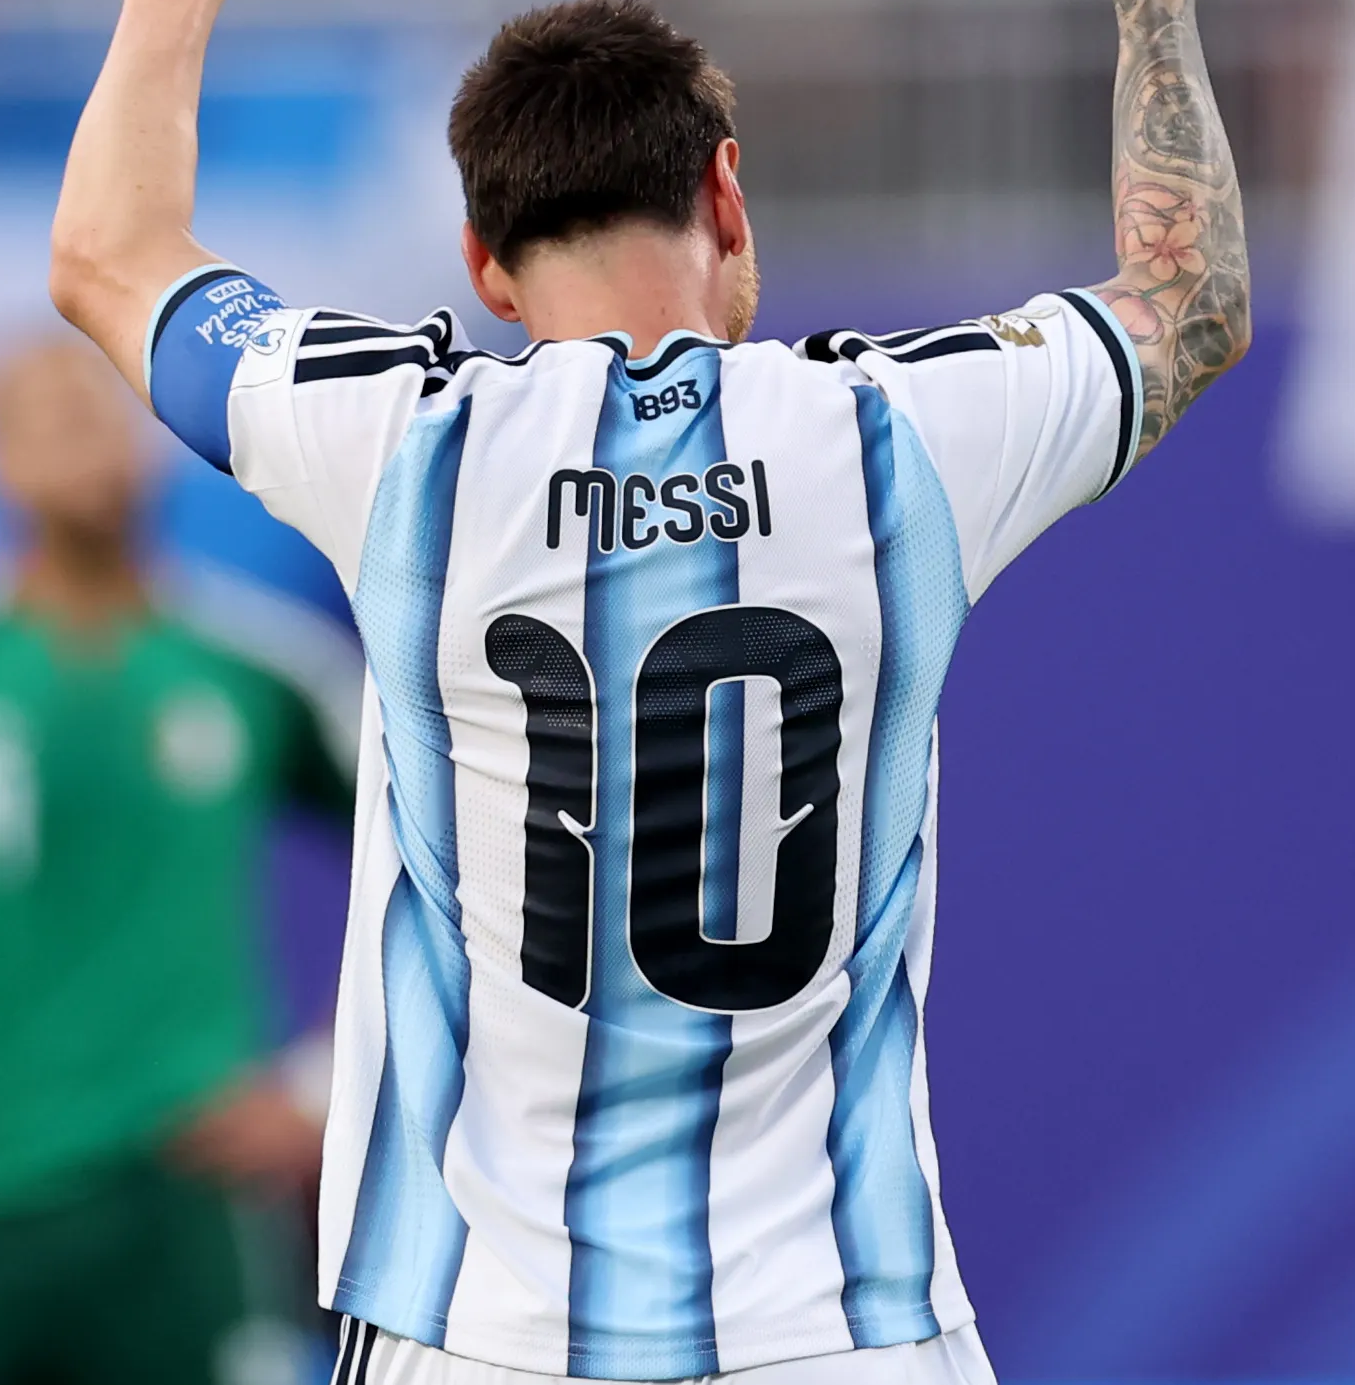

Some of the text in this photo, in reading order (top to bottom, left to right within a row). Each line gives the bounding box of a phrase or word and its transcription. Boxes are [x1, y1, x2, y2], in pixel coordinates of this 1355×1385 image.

[209, 280, 250, 300] FIFA
[195, 294, 263, 344] World
[628, 378, 702, 423] 1893
[546, 459, 773, 554] MESSI
[485, 606, 844, 1015] 10
